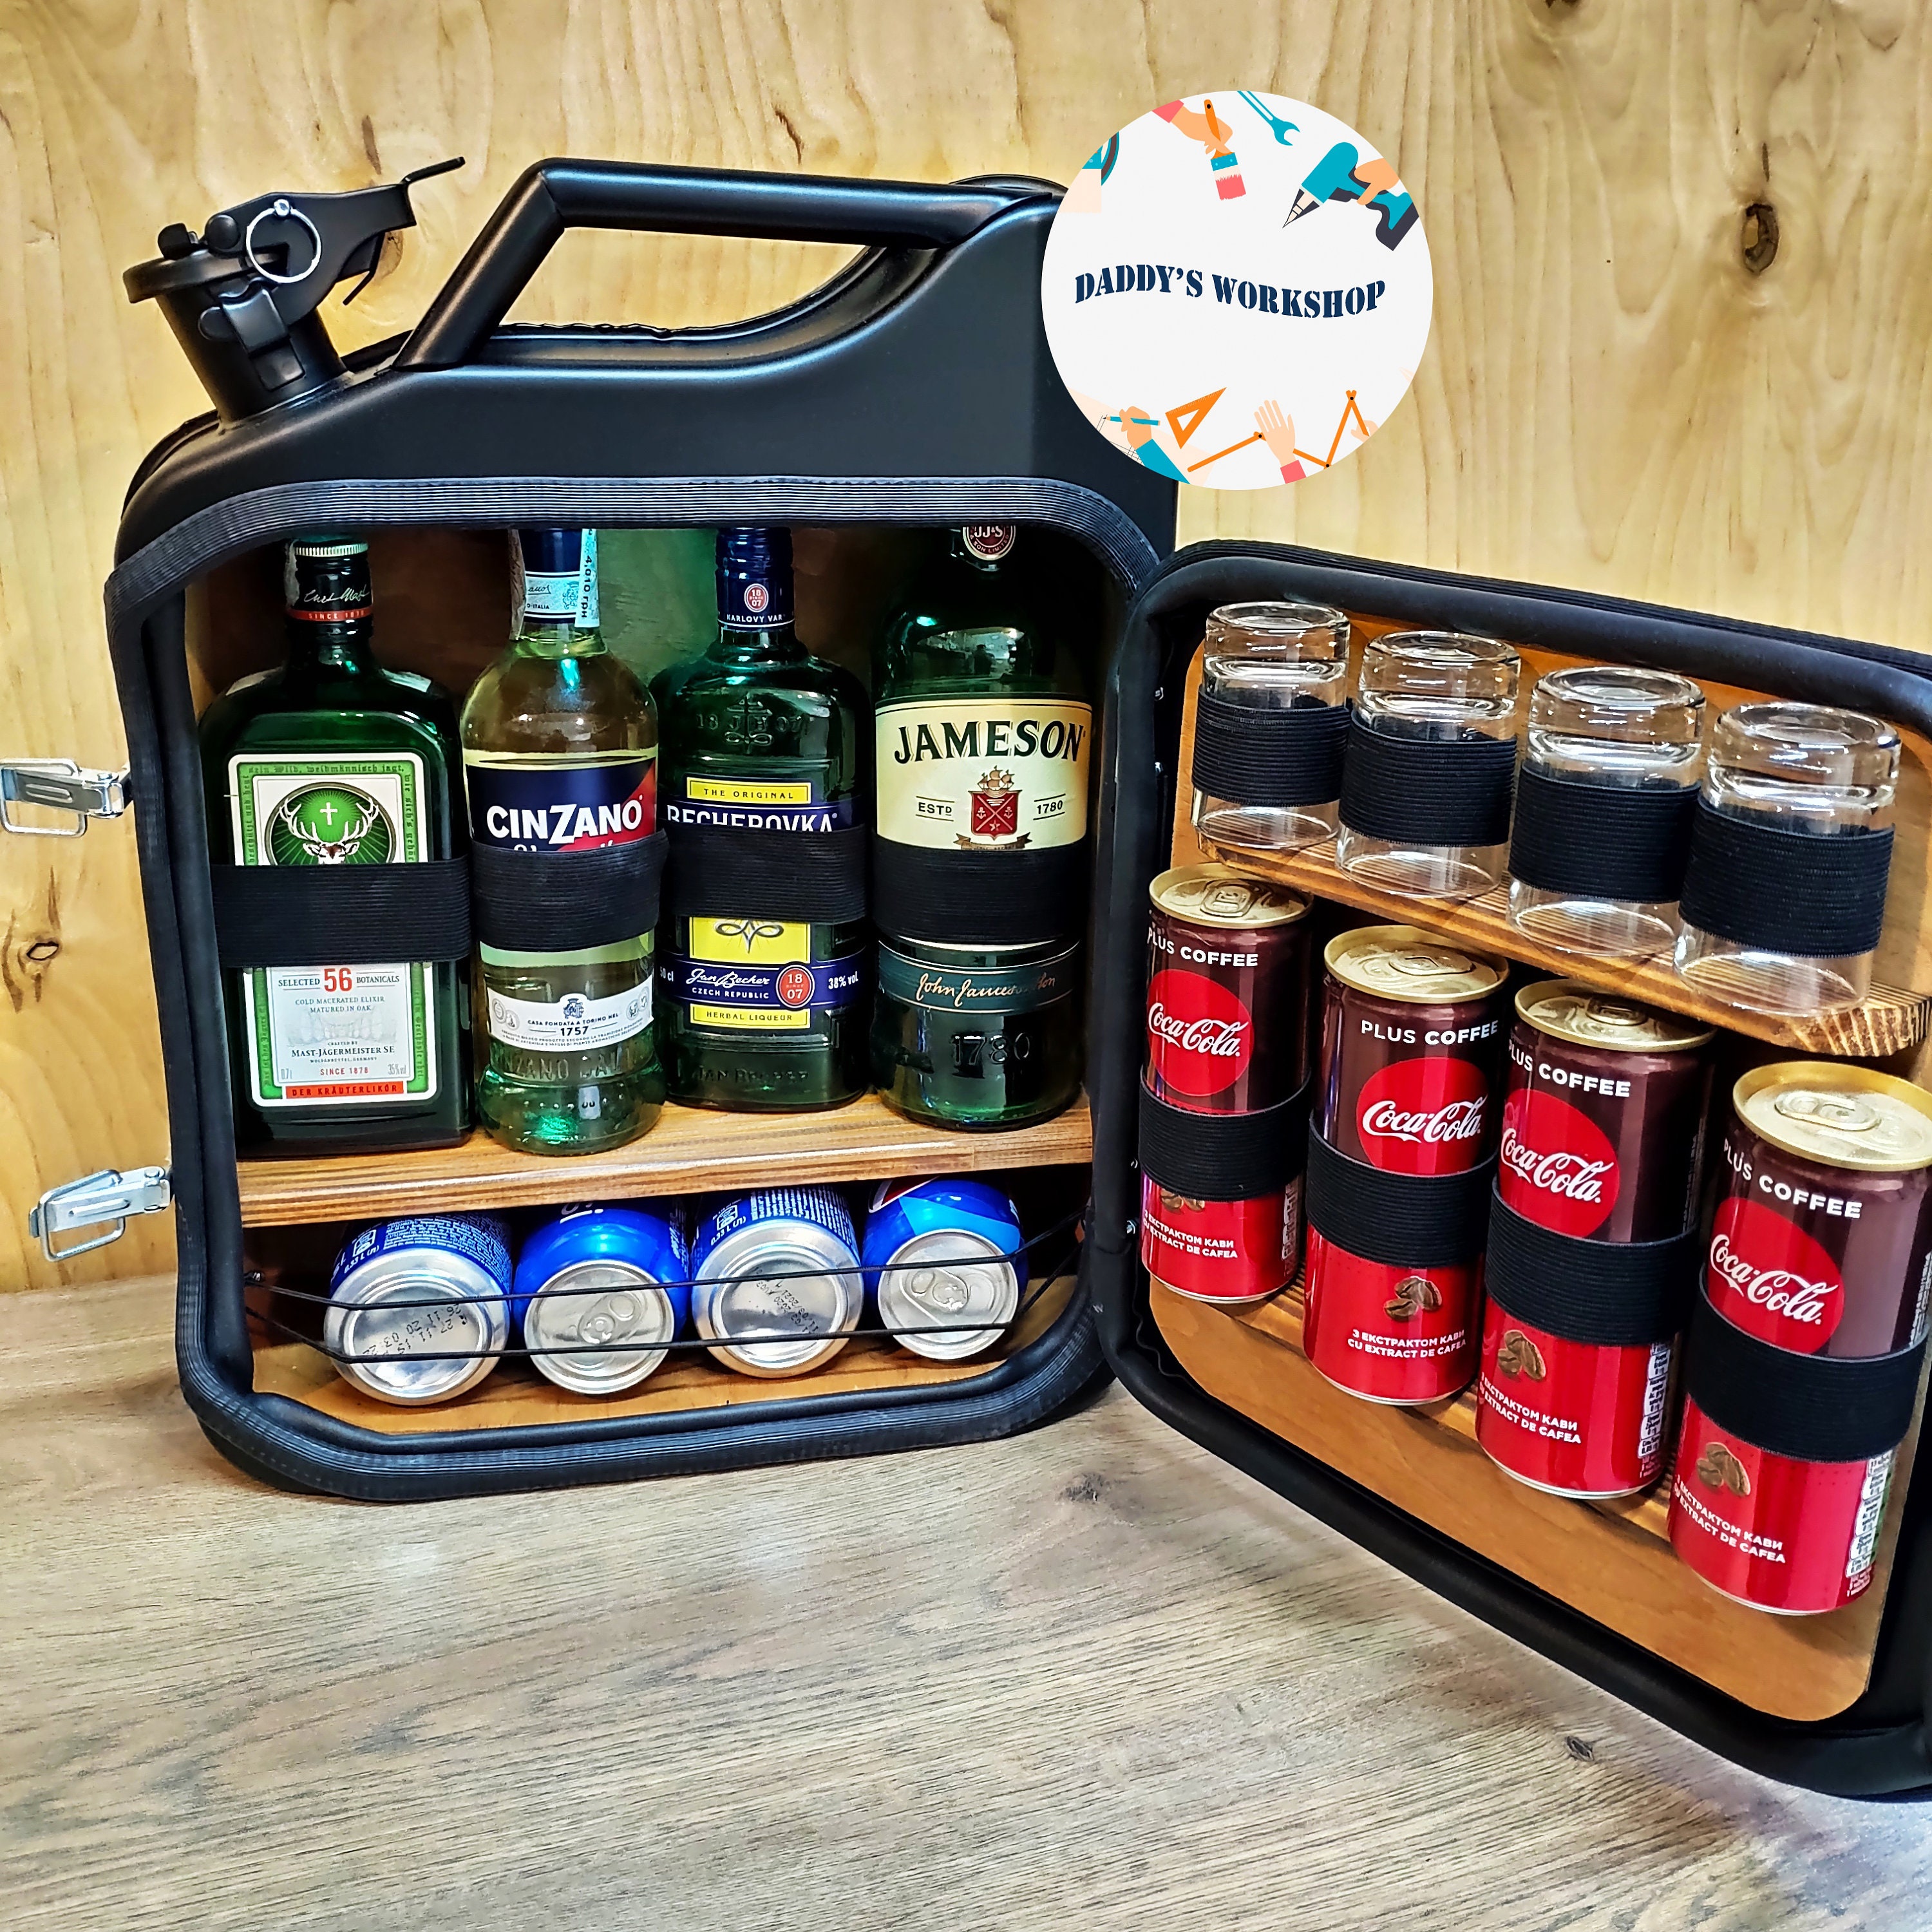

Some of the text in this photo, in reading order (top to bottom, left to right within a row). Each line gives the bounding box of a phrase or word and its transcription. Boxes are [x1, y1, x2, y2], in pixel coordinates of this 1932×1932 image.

[726, 614, 784, 623] KARLOVY VAR
[894, 719, 1084, 764] JAMESON
[704, 788, 793, 799] THE ORIGINAL
[1036, 800, 1063, 815] 1780
[486, 799, 643, 845] CINZANO
[406, 833, 416, 862] gehör
[1147, 926, 1258, 967] PLUS COFFEE
[278, 978, 321, 987] SELECTED
[324, 967, 352, 992] 56
[667, 971, 674, 982] cl
[787, 973, 803, 984] 18
[828, 971, 858, 990] 38% vol
[916, 973, 955, 1001] John
[692, 987, 770, 999] CZECH REPUBLIC
[787, 989, 803, 999] 07
[706, 1011, 744, 1020] HERBAL
[1148, 1002, 1249, 1057] Coca-Cola
[560, 1026, 589, 1037] 1757
[1361, 1019, 1499, 1045] PLUS COFFEE
[951, 1032, 1030, 1066] 1780
[1508, 1038, 1631, 1097] PLUS COFFEE
[318, 1084, 397, 1095] KRÄUTERLIKÖR
[1362, 1094, 1488, 1144] Coca-Cola
[1501, 1128, 1614, 1203] Coca-Cola
[1723, 1137, 1753, 1181] PLUS
[1759, 1175, 1862, 1220] COFFEE
[1148, 1213, 1202, 1245] ЕКСТРАКТОМ
[1204, 1238, 1234, 1248] КАВИ
[1150, 1225, 1185, 1251] EXTRACT
[1186, 1245, 1200, 1255] DE
[1202, 1247, 1238, 1258] CAFEA
[1710, 1234, 1839, 1325] Coca-Cola
[1347, 1338, 1466, 1358] CU EXTRACT DE CAFEA
[1361, 1331, 1437, 1348] ЕКСТРАКТОМ
[1439, 1329, 1465, 1345] КАВИ
[1484, 1376, 1540, 1421] ЕКСТРАКТОМ
[1542, 1414, 1578, 1432] КАВИ
[1484, 1390, 1520, 1424] EXTRACT
[1521, 1418, 1536, 1432] DE
[1539, 1425, 1582, 1444] CAFEA
[1680, 1481, 1741, 1537] ЕКСТРАКТОМ
[1743, 1530, 1783, 1551] КАВИ
[1680, 1495, 1719, 1537] EXTRACT
[1720, 1533, 1737, 1548] DE
[1740, 1542, 1786, 1564] CAFEA
